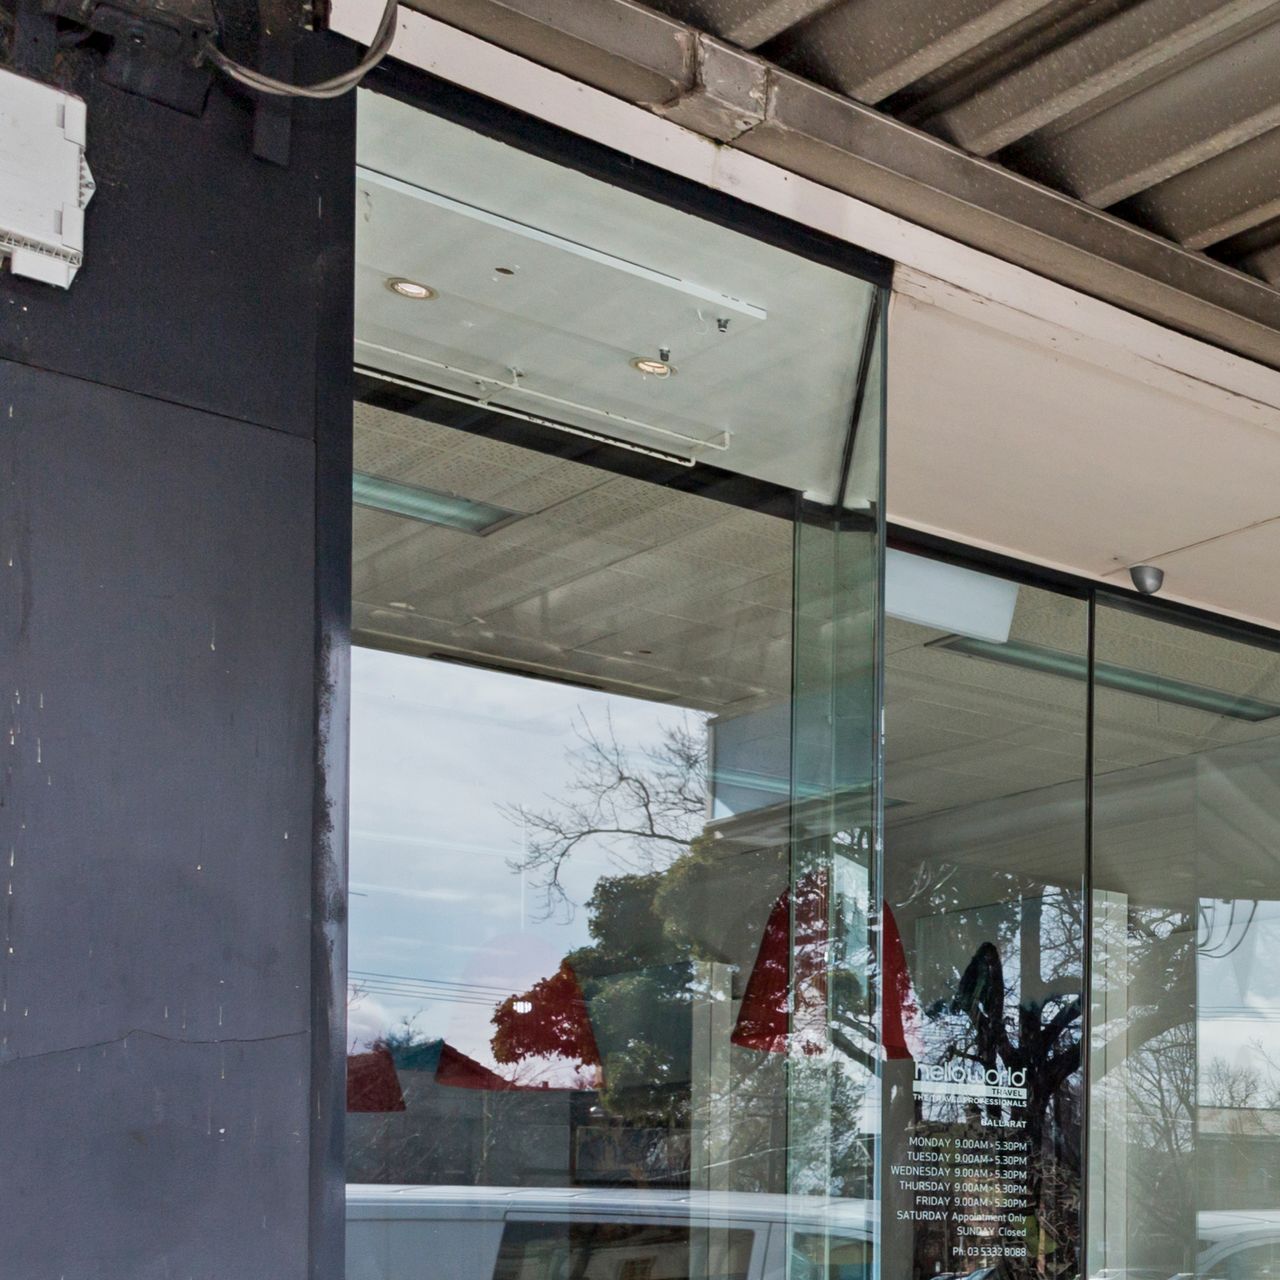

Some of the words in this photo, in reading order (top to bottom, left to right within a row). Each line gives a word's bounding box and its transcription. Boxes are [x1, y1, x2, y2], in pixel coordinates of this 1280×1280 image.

[991, 1087, 1023, 1097] TRAVEL
[980, 1118, 1027, 1129] BALLARAT
[909, 1137, 951, 1147] MONDAY
[907, 1151, 951, 1162] TUESDAY
[890, 1165, 951, 1176] WEDNESDAY
[899, 1180, 951, 1191] THURSDAY
[915, 1195, 951, 1206] FRIDAY
[896, 1210, 948, 1221] SATURDAY
[952, 1212, 1006, 1223] Appointment
[1008, 1212, 1027, 1224] Only
[956, 1226, 995, 1237] SUNDAY
[998, 1227, 1027, 1237] Closed
[967, 1247, 980, 1257] 03
